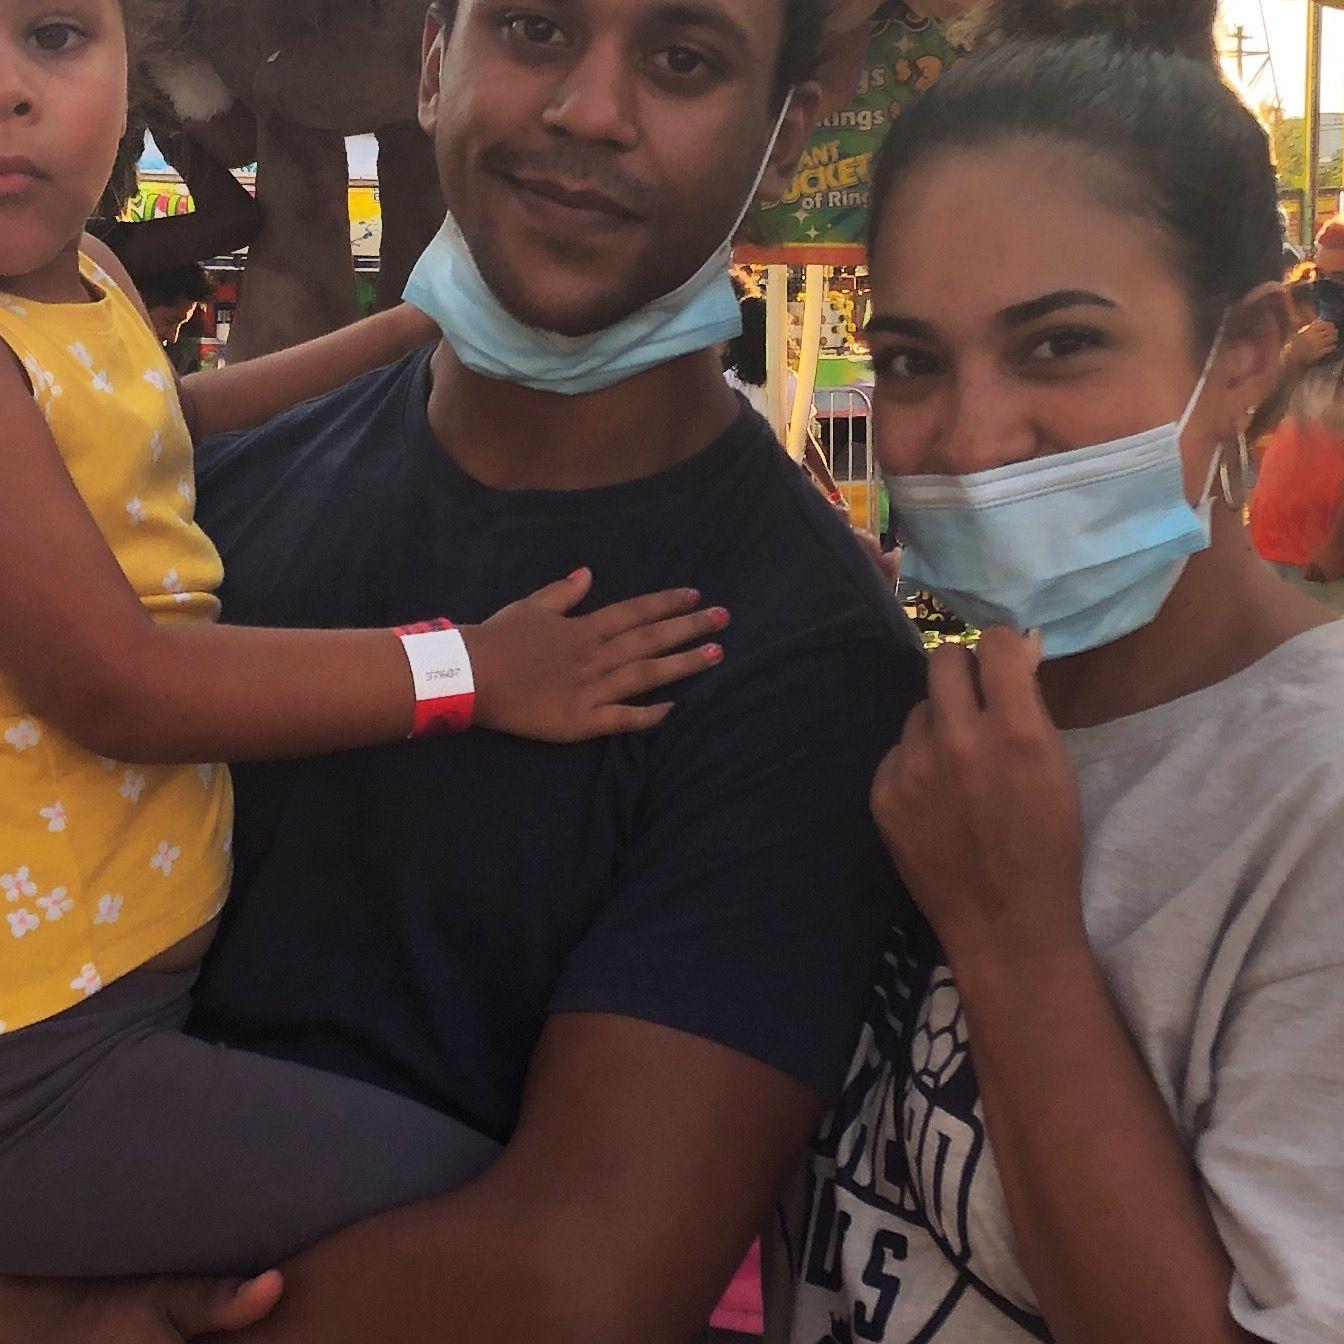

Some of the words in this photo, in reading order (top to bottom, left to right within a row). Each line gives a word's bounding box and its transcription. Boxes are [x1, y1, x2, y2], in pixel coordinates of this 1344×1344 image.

[817, 109, 885, 131] ings
[796, 140, 841, 172] ANT
[774, 153, 872, 205] UCKET
[801, 192, 824, 209] of
[828, 190, 870, 208] Rin
